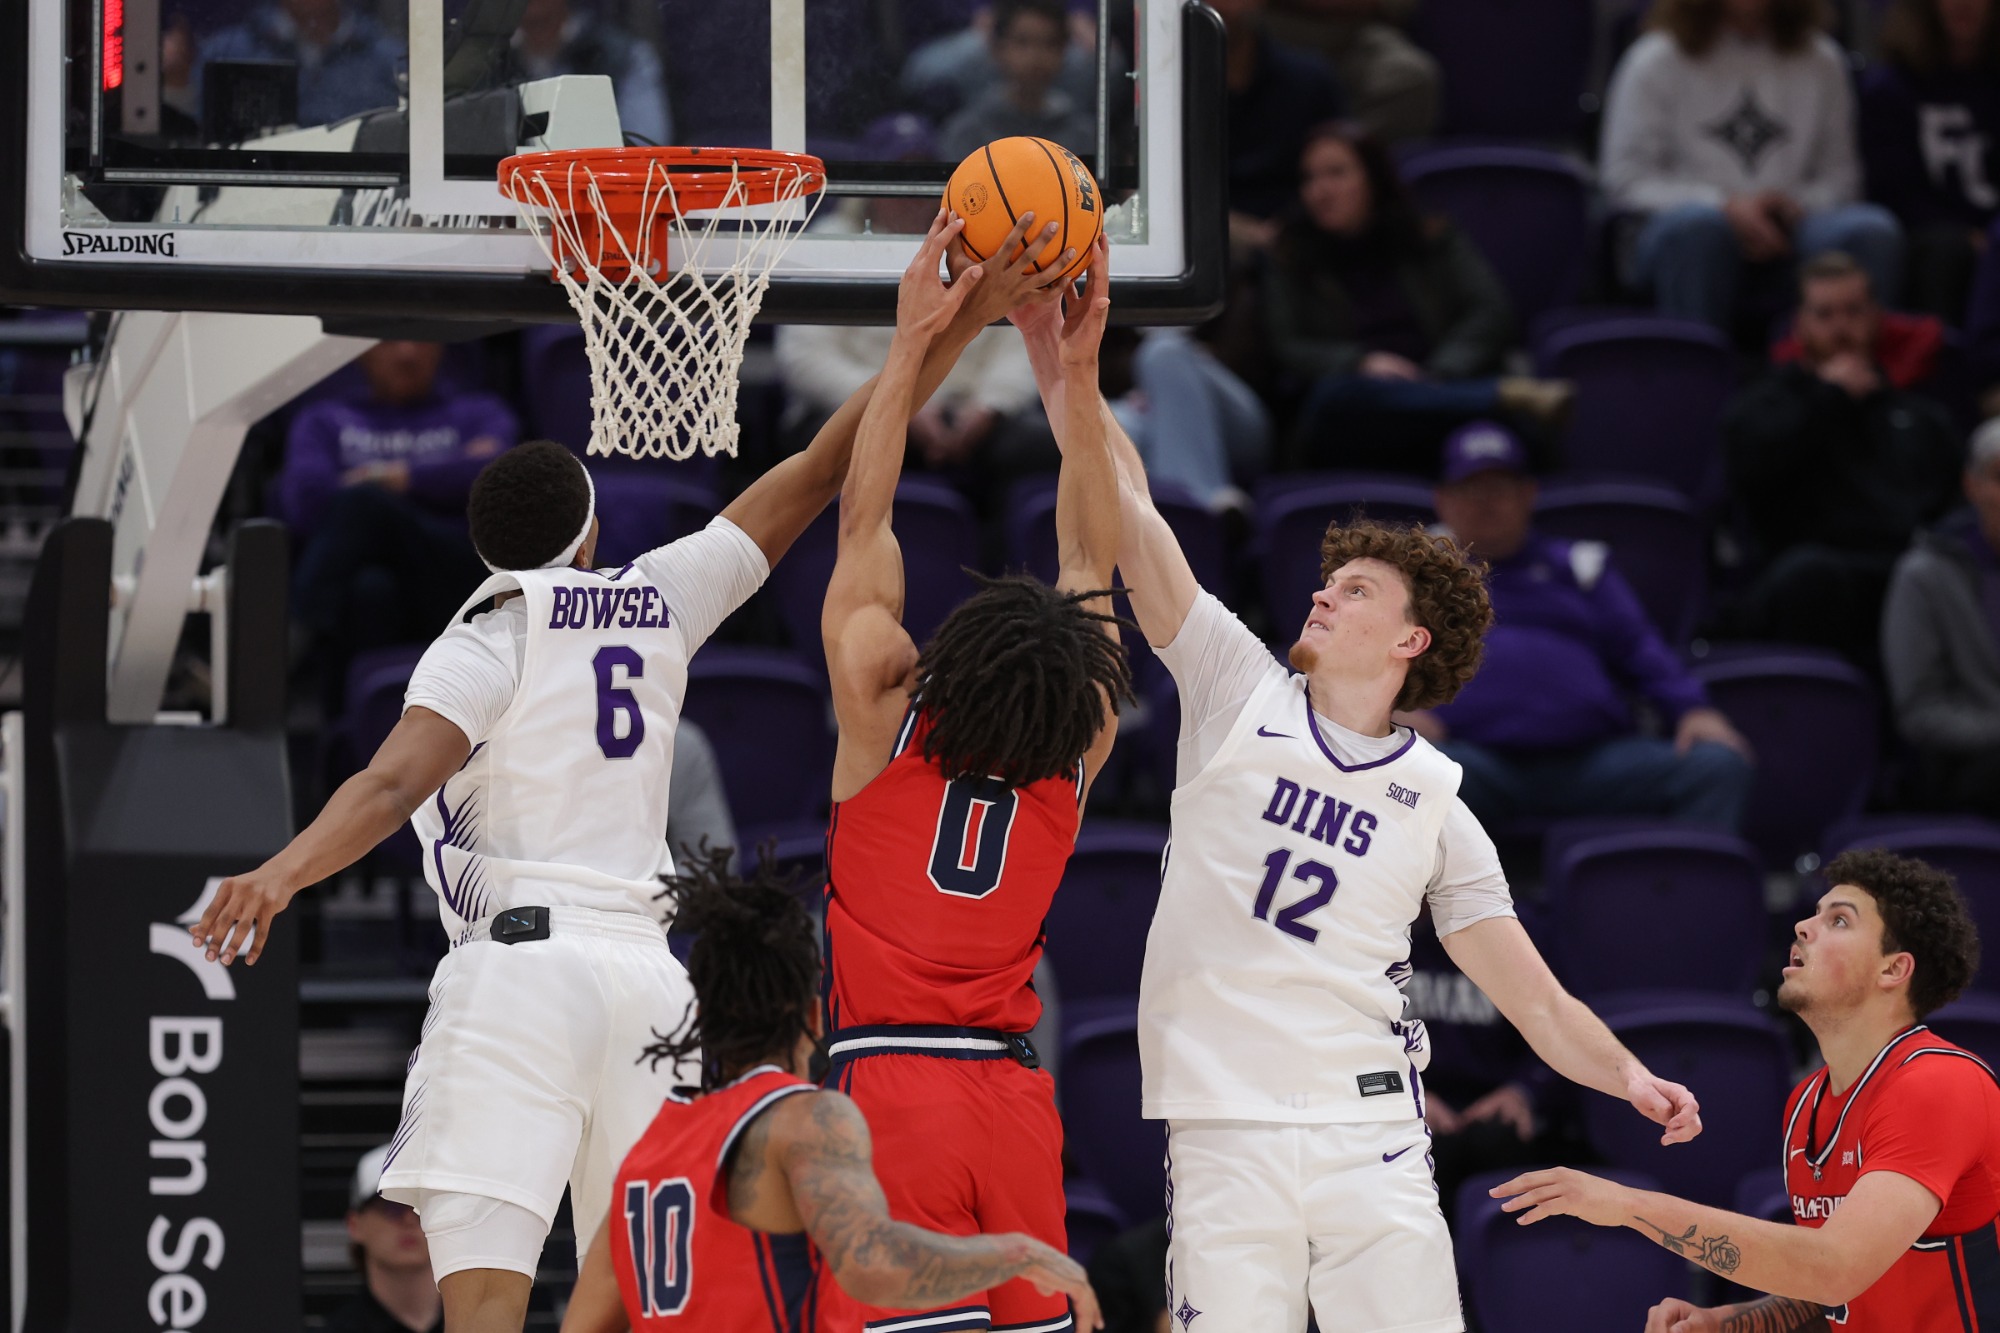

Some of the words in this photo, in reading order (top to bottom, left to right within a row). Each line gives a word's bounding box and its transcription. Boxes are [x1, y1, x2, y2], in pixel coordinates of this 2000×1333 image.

[63, 231, 175, 257] SPALDING
[590, 644, 646, 760] 6
[926, 770, 1019, 900] 0
[1261, 776, 1378, 858] DINS
[1251, 846, 1340, 945] 12
[148, 1016, 223, 1196] Bon
[147, 1214, 226, 1333] Se
[624, 1176, 696, 1319] 10
